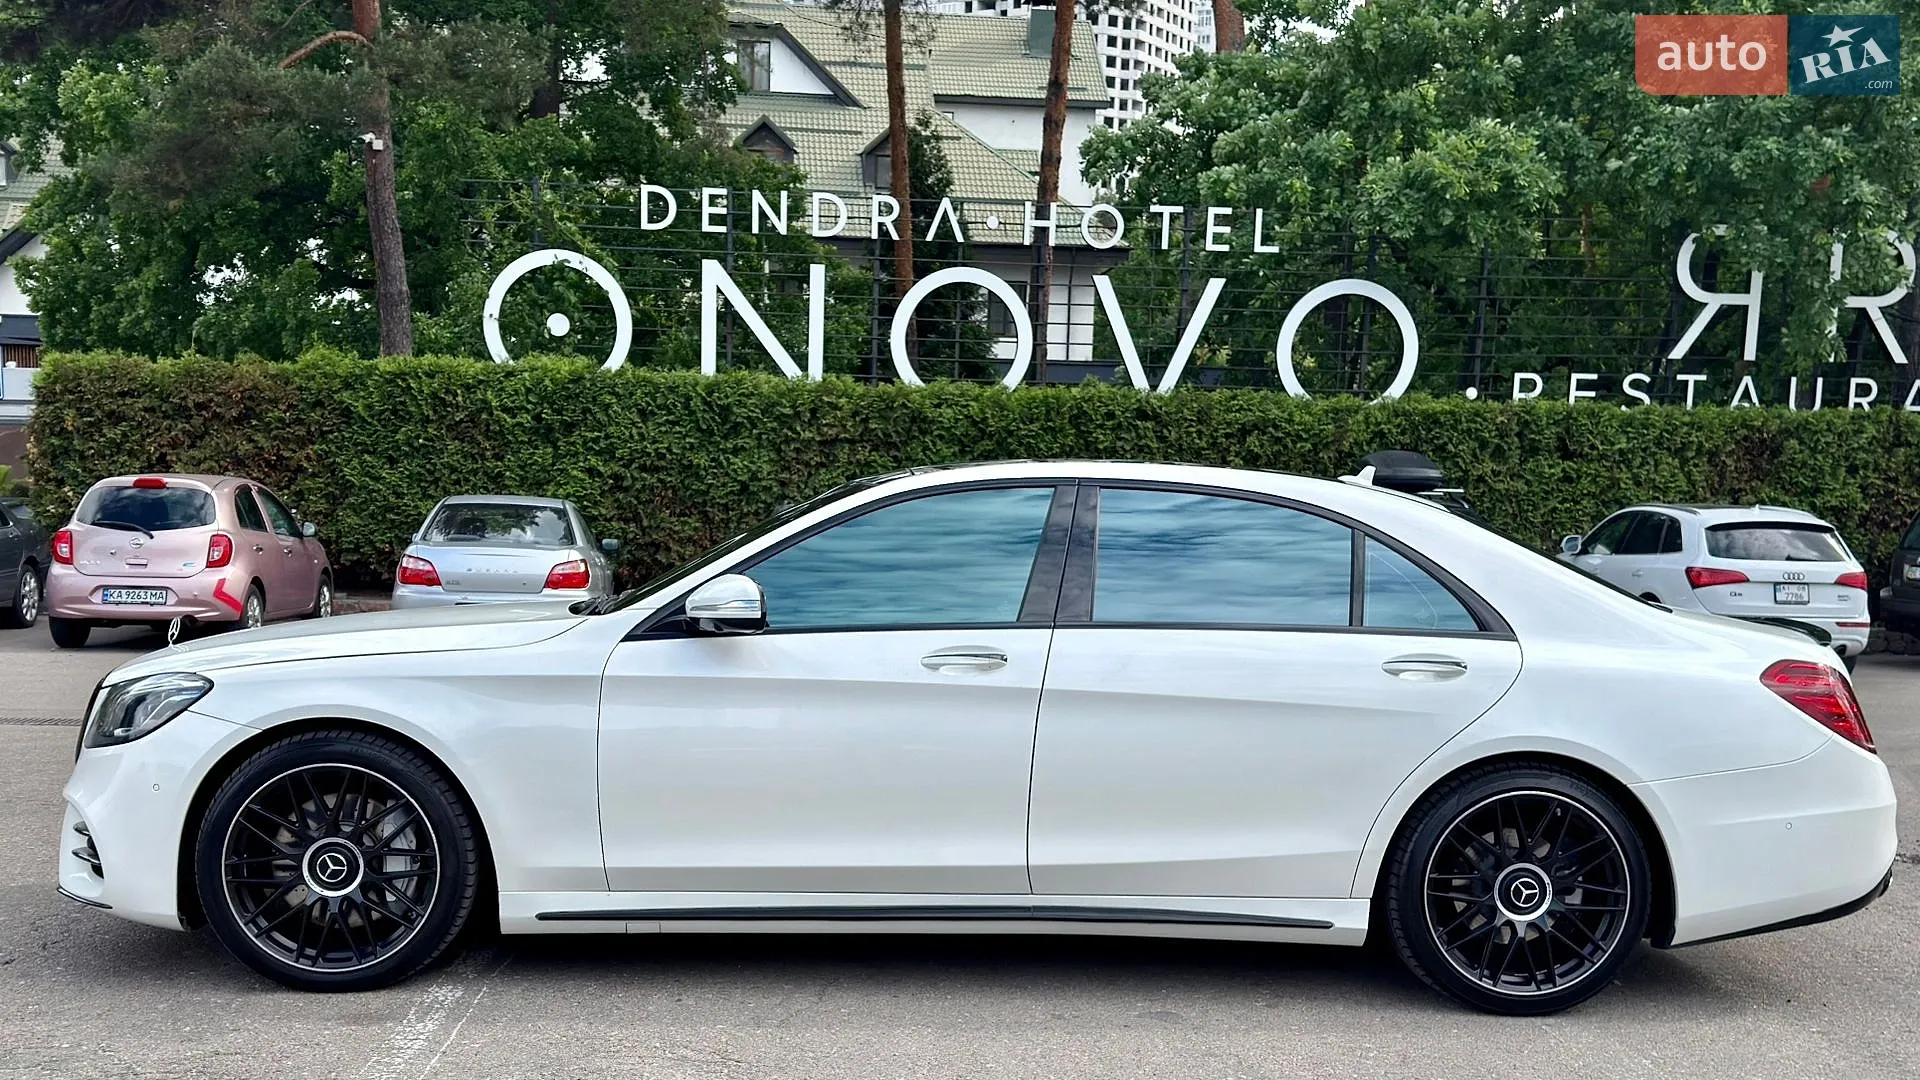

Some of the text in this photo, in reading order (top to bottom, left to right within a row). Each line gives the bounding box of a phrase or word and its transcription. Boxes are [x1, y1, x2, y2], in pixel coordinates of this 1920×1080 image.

[639, 184, 1281, 254] DENDRA HOTEL
[483, 248, 1419, 404] ONOVO
[108, 590, 164, 601] KA 9263 MA
